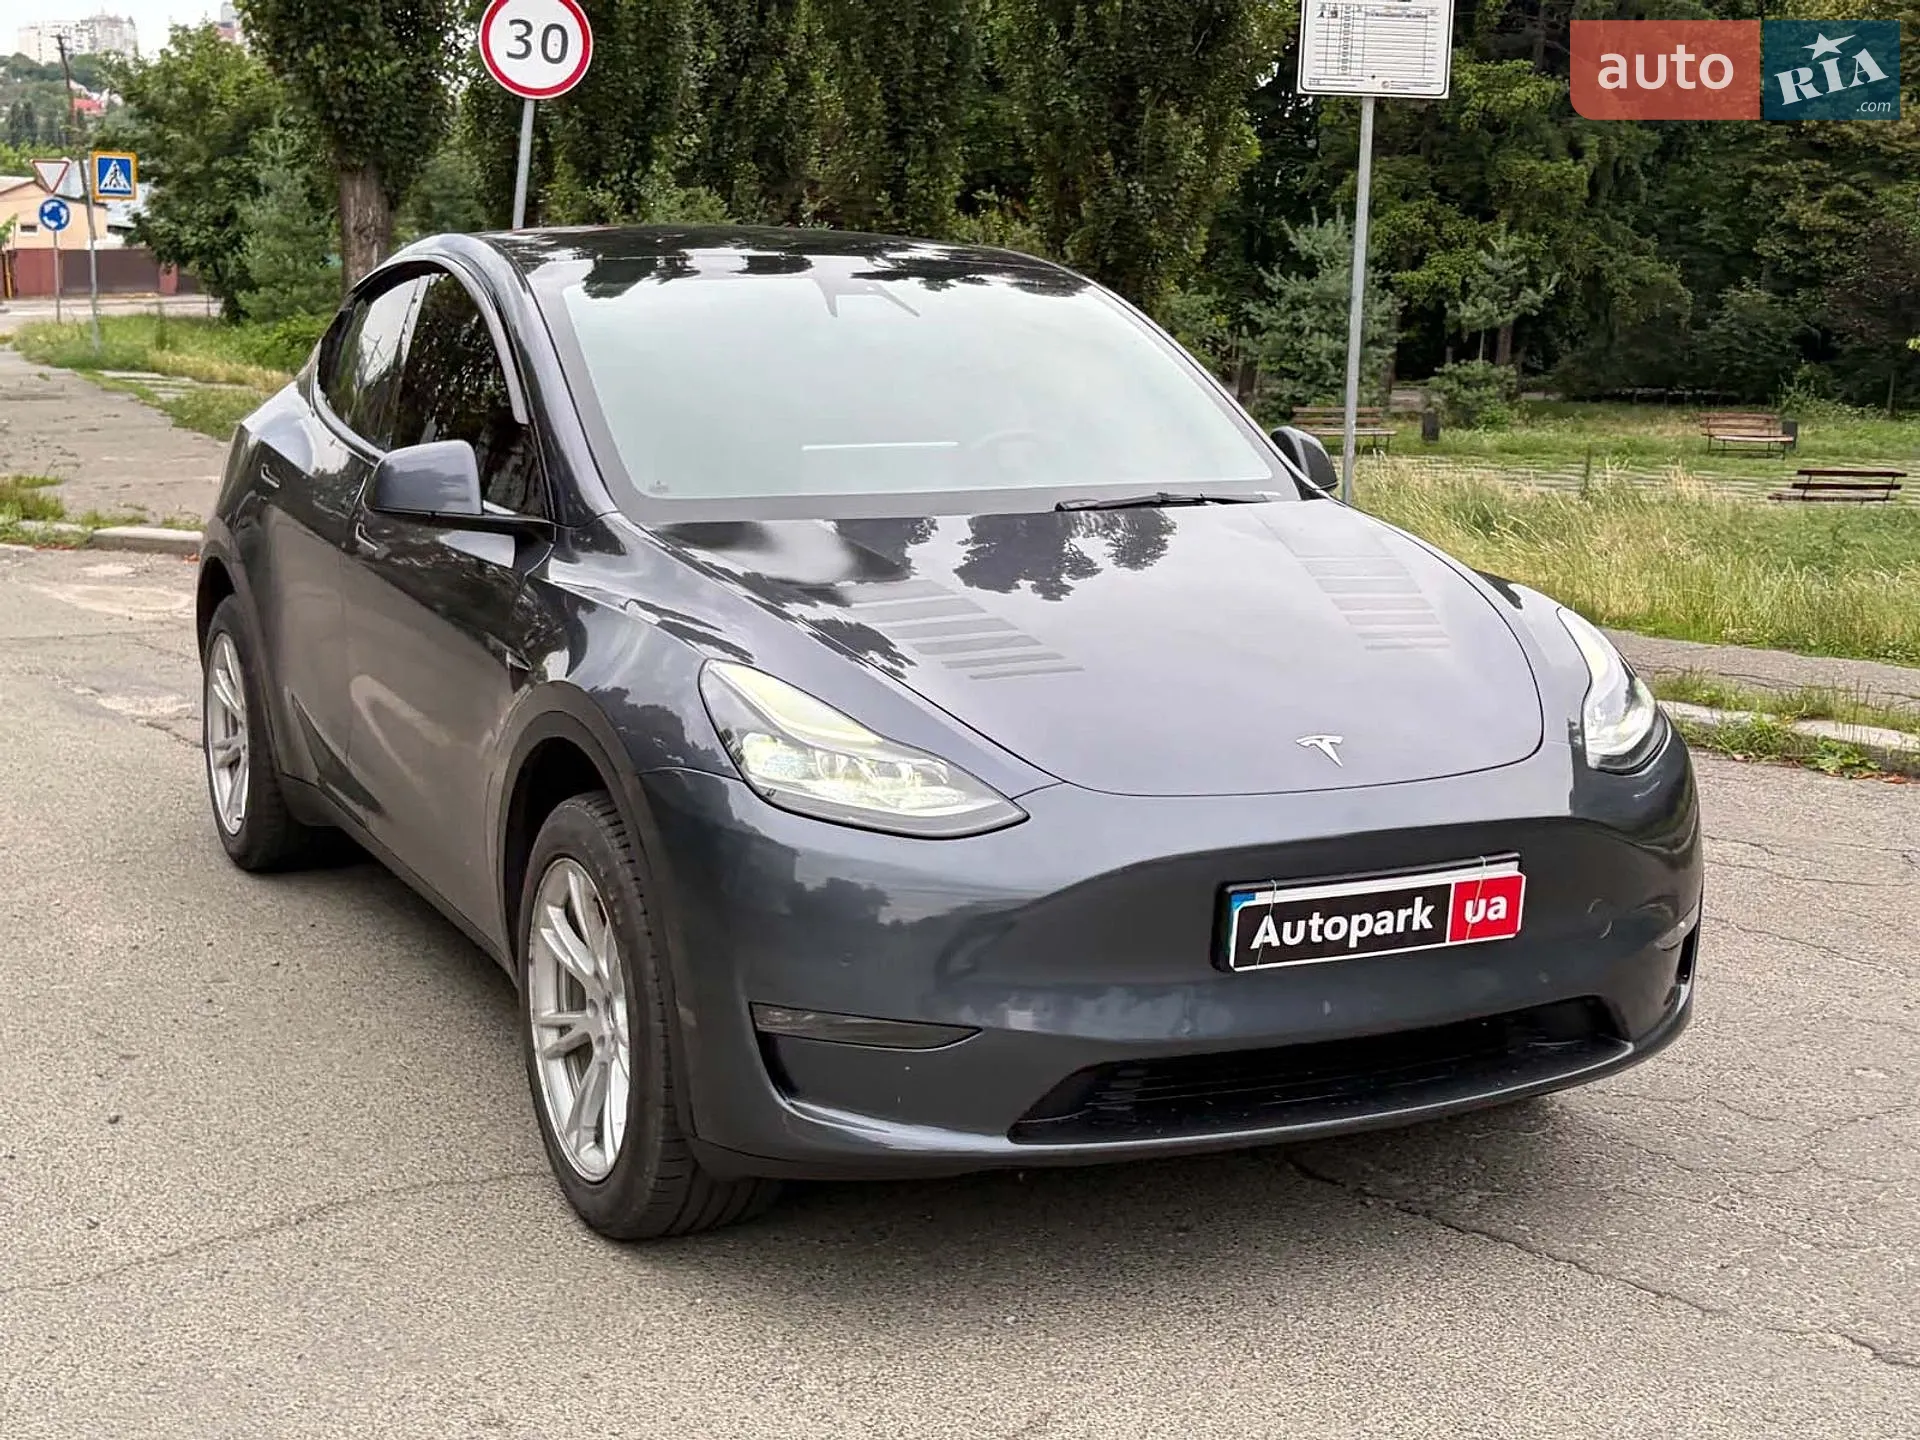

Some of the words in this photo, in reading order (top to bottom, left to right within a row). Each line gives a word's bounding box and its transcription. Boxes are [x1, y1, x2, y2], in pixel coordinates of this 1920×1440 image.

[506, 18, 569, 65] 30
[1250, 896, 1434, 950] Autopark
[1464, 896, 1508, 925] ua
